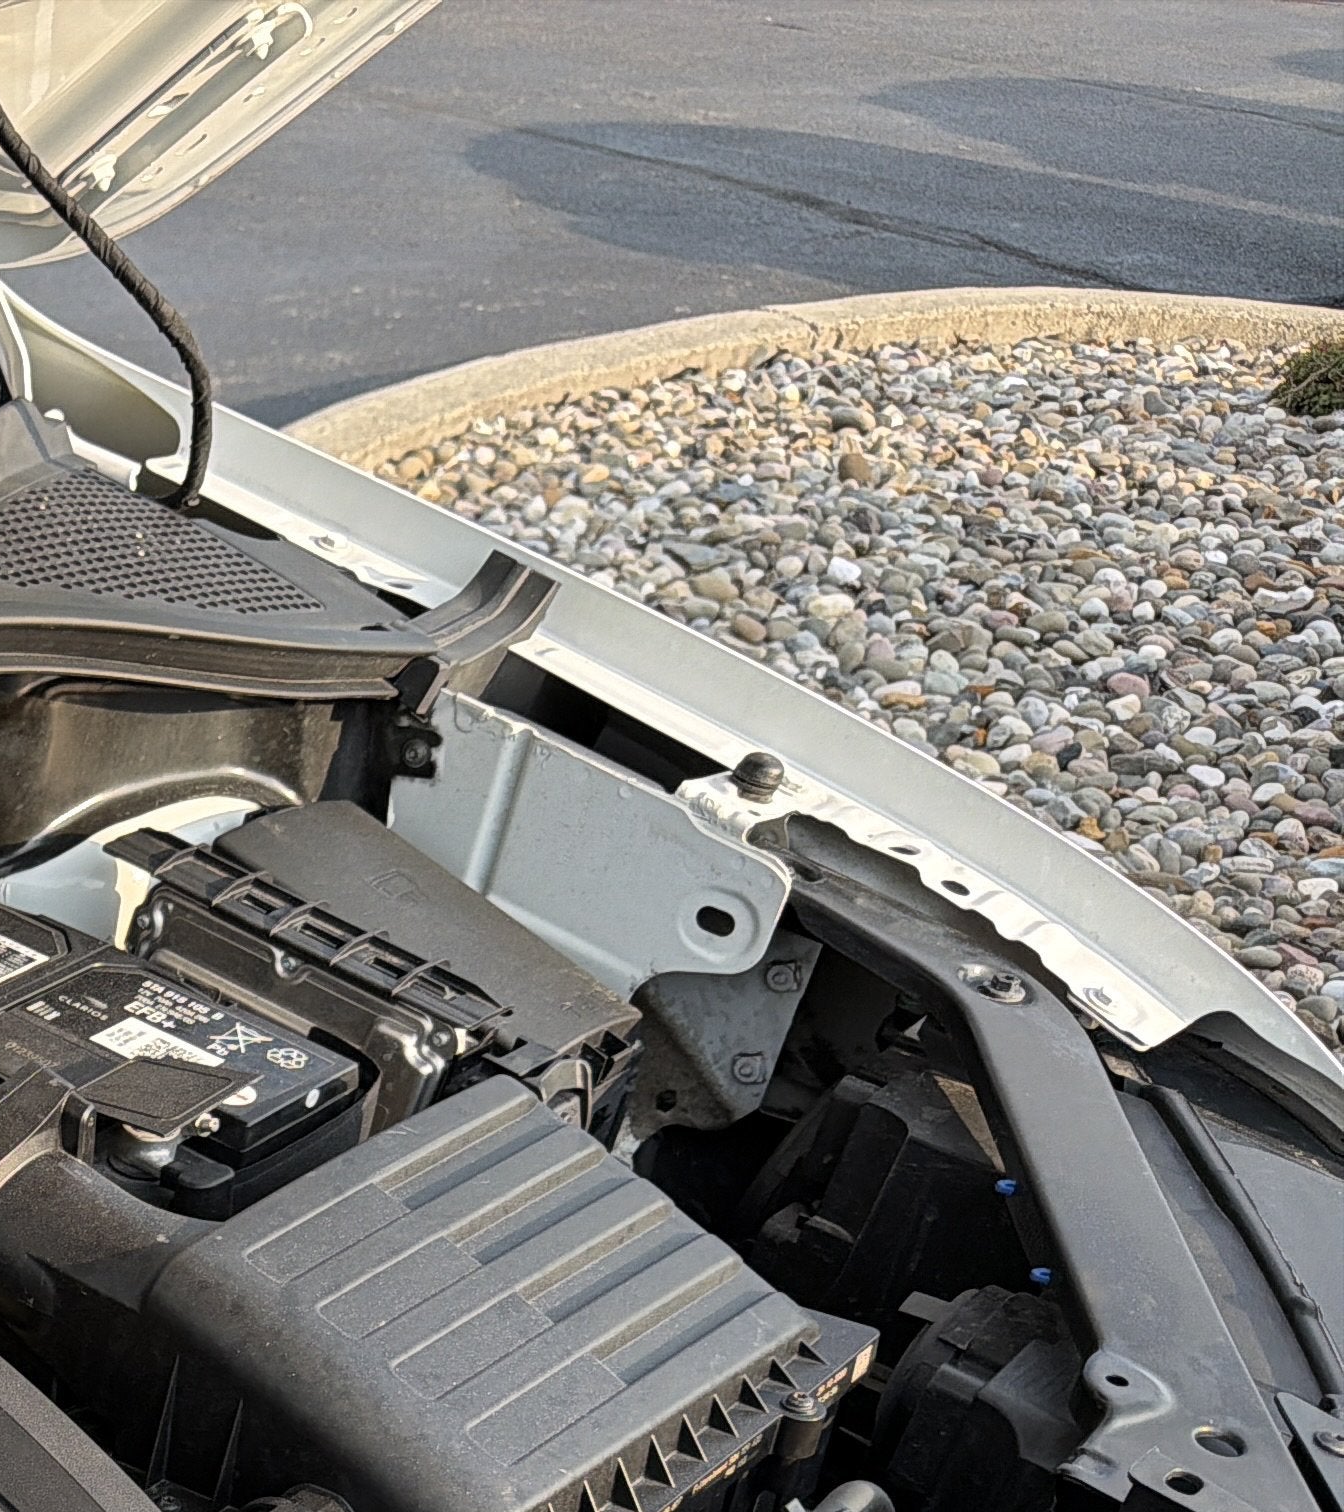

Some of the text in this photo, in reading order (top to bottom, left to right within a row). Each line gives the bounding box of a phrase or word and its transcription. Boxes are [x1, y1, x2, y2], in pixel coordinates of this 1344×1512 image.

[58, 995, 108, 1020] CLARIOS
[123, 1001, 176, 1028] EFB+
[206, 1043, 229, 1056] Pb
